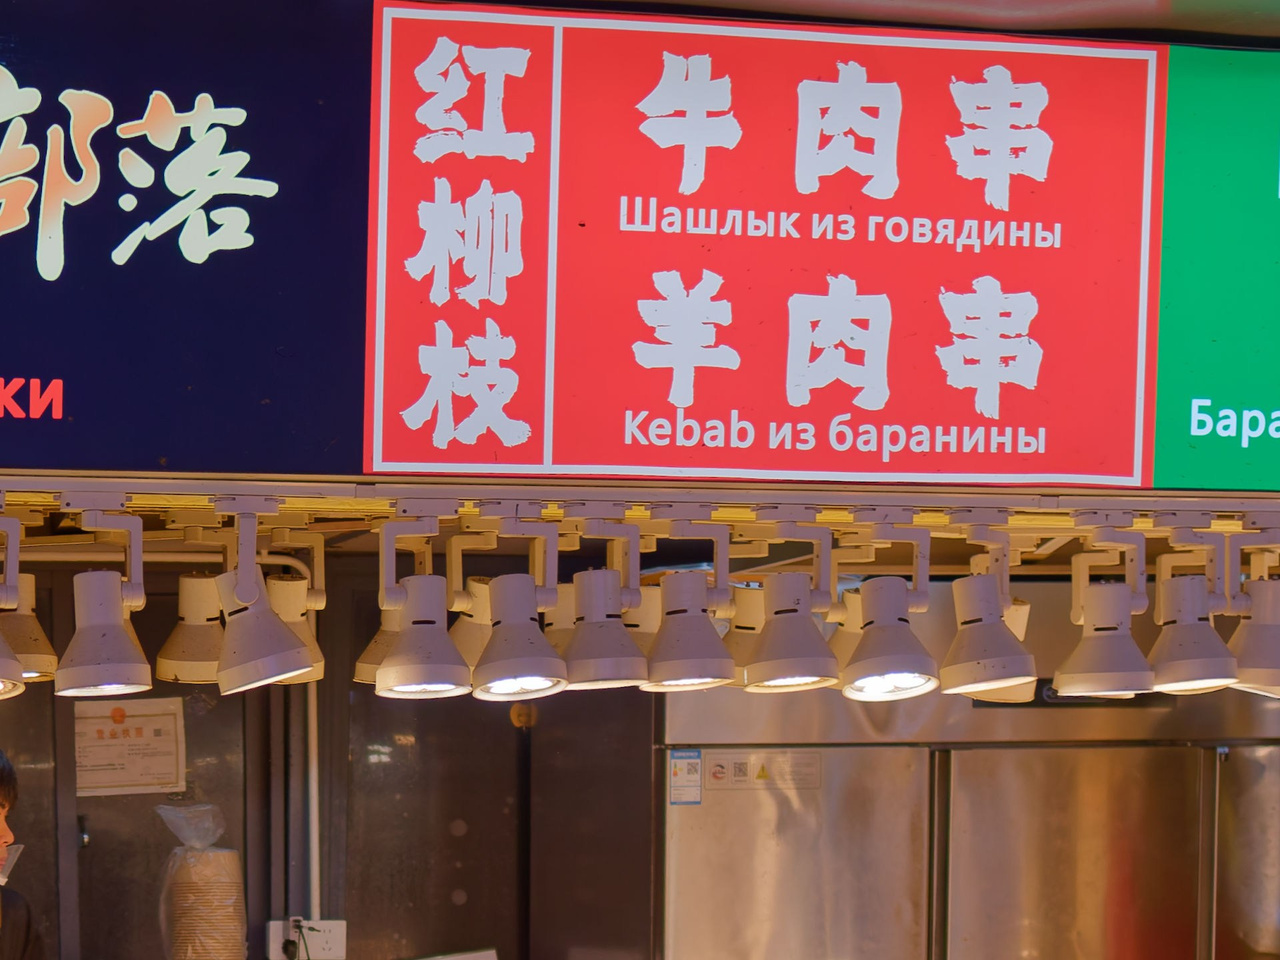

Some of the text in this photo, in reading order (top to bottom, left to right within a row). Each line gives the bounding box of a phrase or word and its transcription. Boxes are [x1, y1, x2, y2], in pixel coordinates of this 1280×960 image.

[634, 50, 1054, 212] 牛肉串
[401, 36, 535, 450] 红柳枝
[619, 195, 1062, 254] Шашлык из говядины
[631, 268, 1044, 420] 羊肉串
[624, 409, 1046, 463] Kebab из баранины
[1190, 398, 1280, 448] Бара
